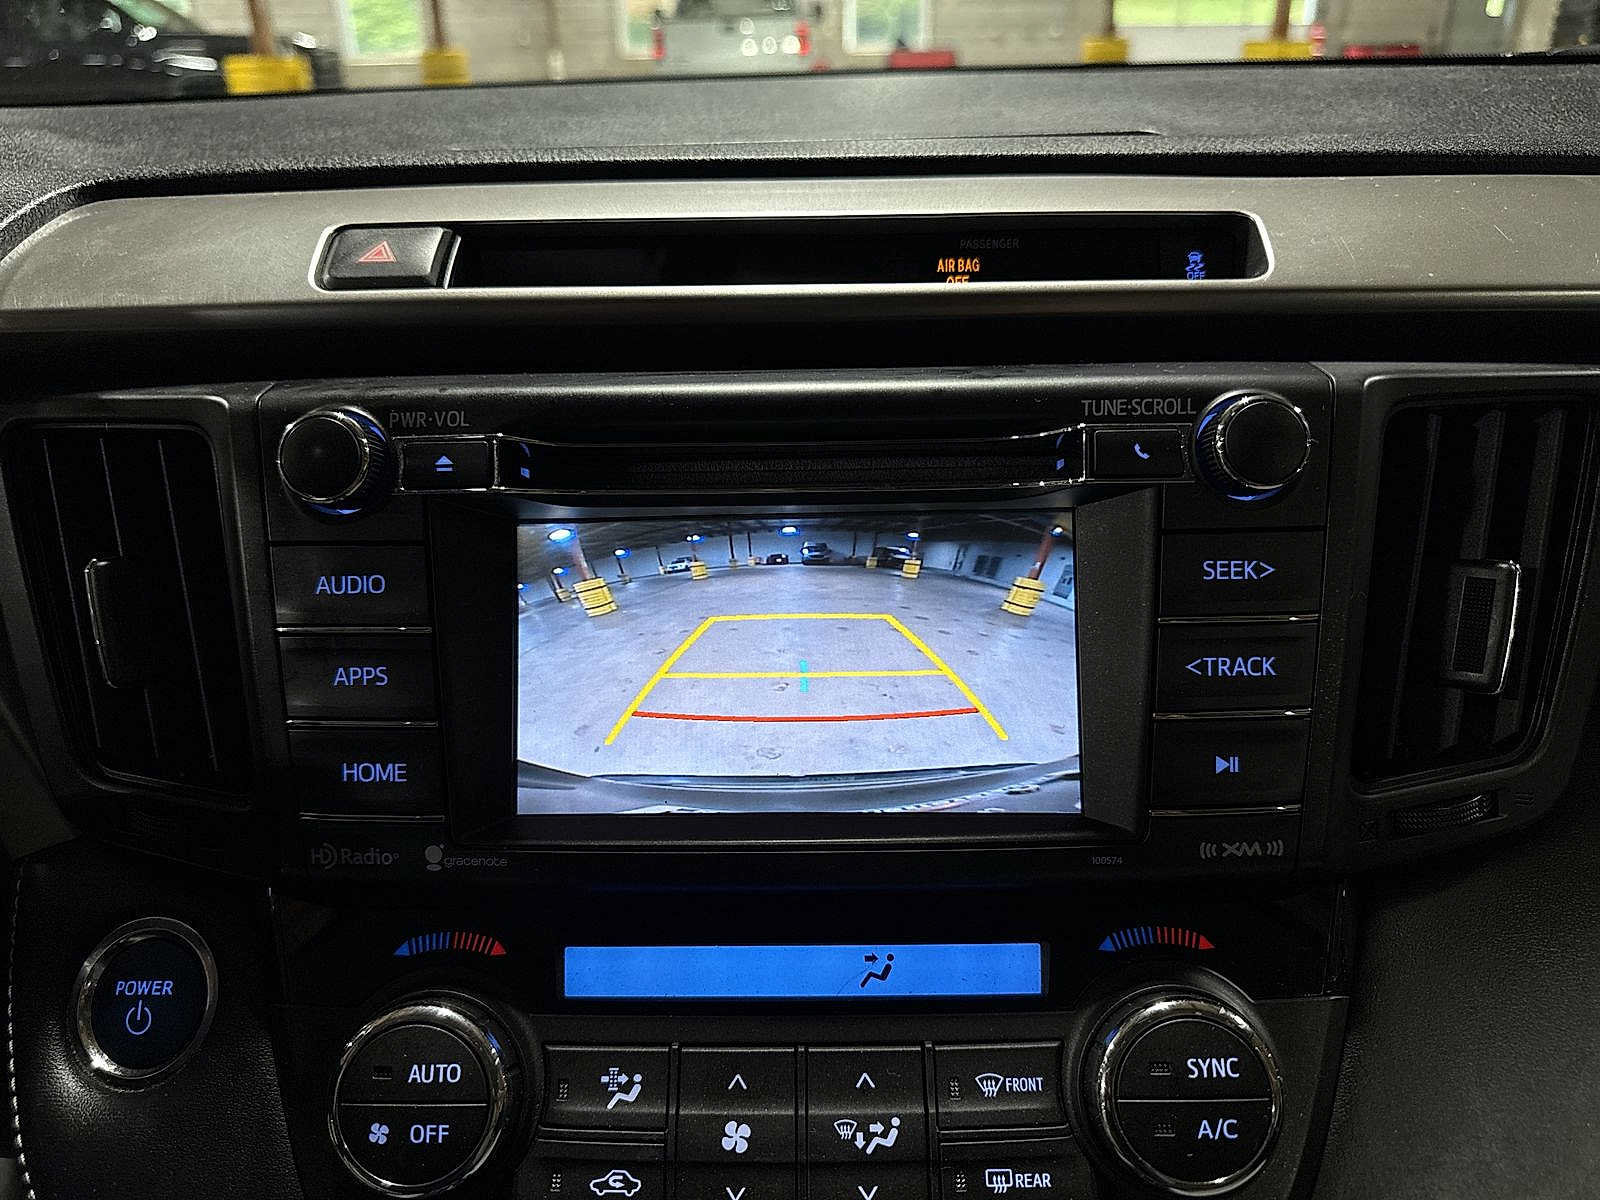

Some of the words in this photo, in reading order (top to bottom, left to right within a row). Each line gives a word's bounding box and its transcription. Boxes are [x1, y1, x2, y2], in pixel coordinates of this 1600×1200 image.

[936, 258, 956, 273] AIR
[957, 257, 981, 273] BAG
[315, 574, 386, 596] AUDIO
[333, 666, 389, 687] APPS
[342, 762, 408, 783] HOME
[444, 855, 509, 868] gracenote
[114, 980, 174, 997] POWER
[407, 1063, 462, 1084] AUTO
[1186, 1057, 1241, 1079] SYNC
[1005, 1076, 1044, 1094] FRONT
[408, 1123, 451, 1144] OFF
[1197, 1118, 1239, 1140] A/C
[1014, 1171, 1052, 1190] REAR
